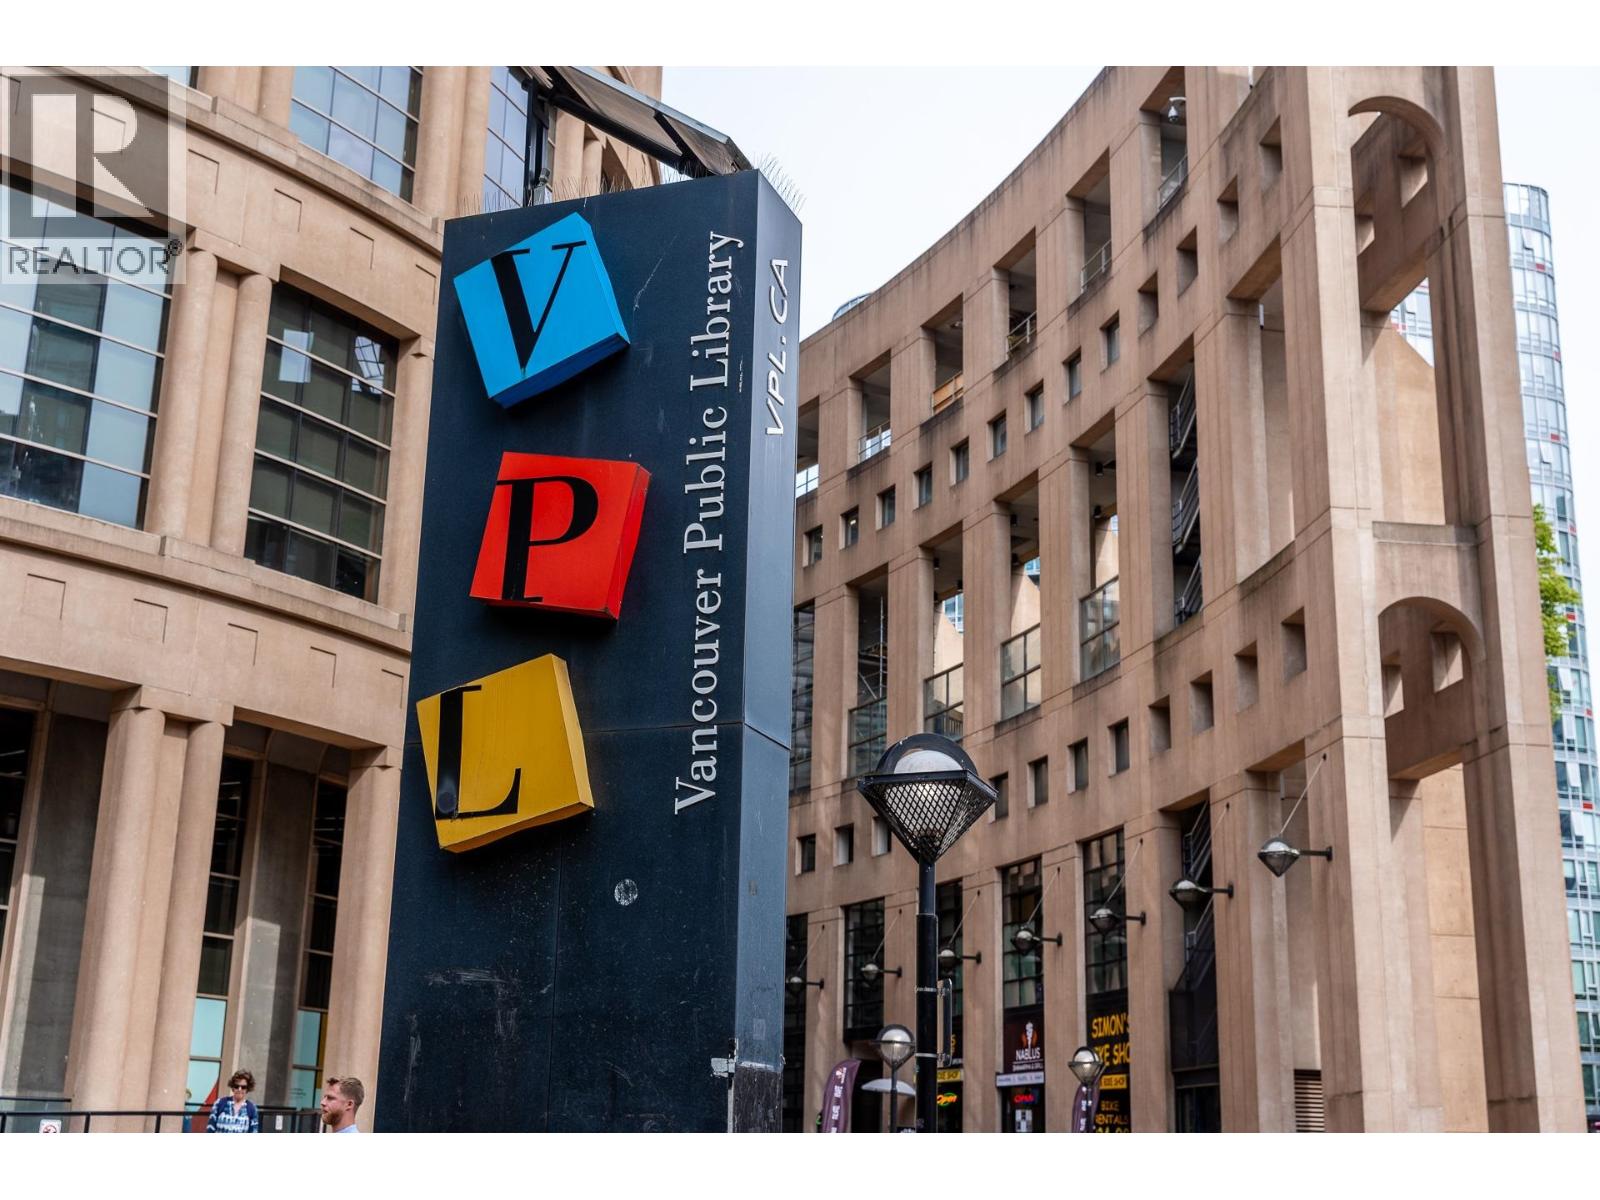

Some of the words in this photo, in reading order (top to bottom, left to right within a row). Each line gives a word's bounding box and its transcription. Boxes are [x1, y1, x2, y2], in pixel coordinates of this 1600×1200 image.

[689, 231, 744, 391] Library
[683, 405, 728, 554] Public
[674, 569, 722, 815] Vancouver
[1015, 1047, 1041, 1061] NABLUS
